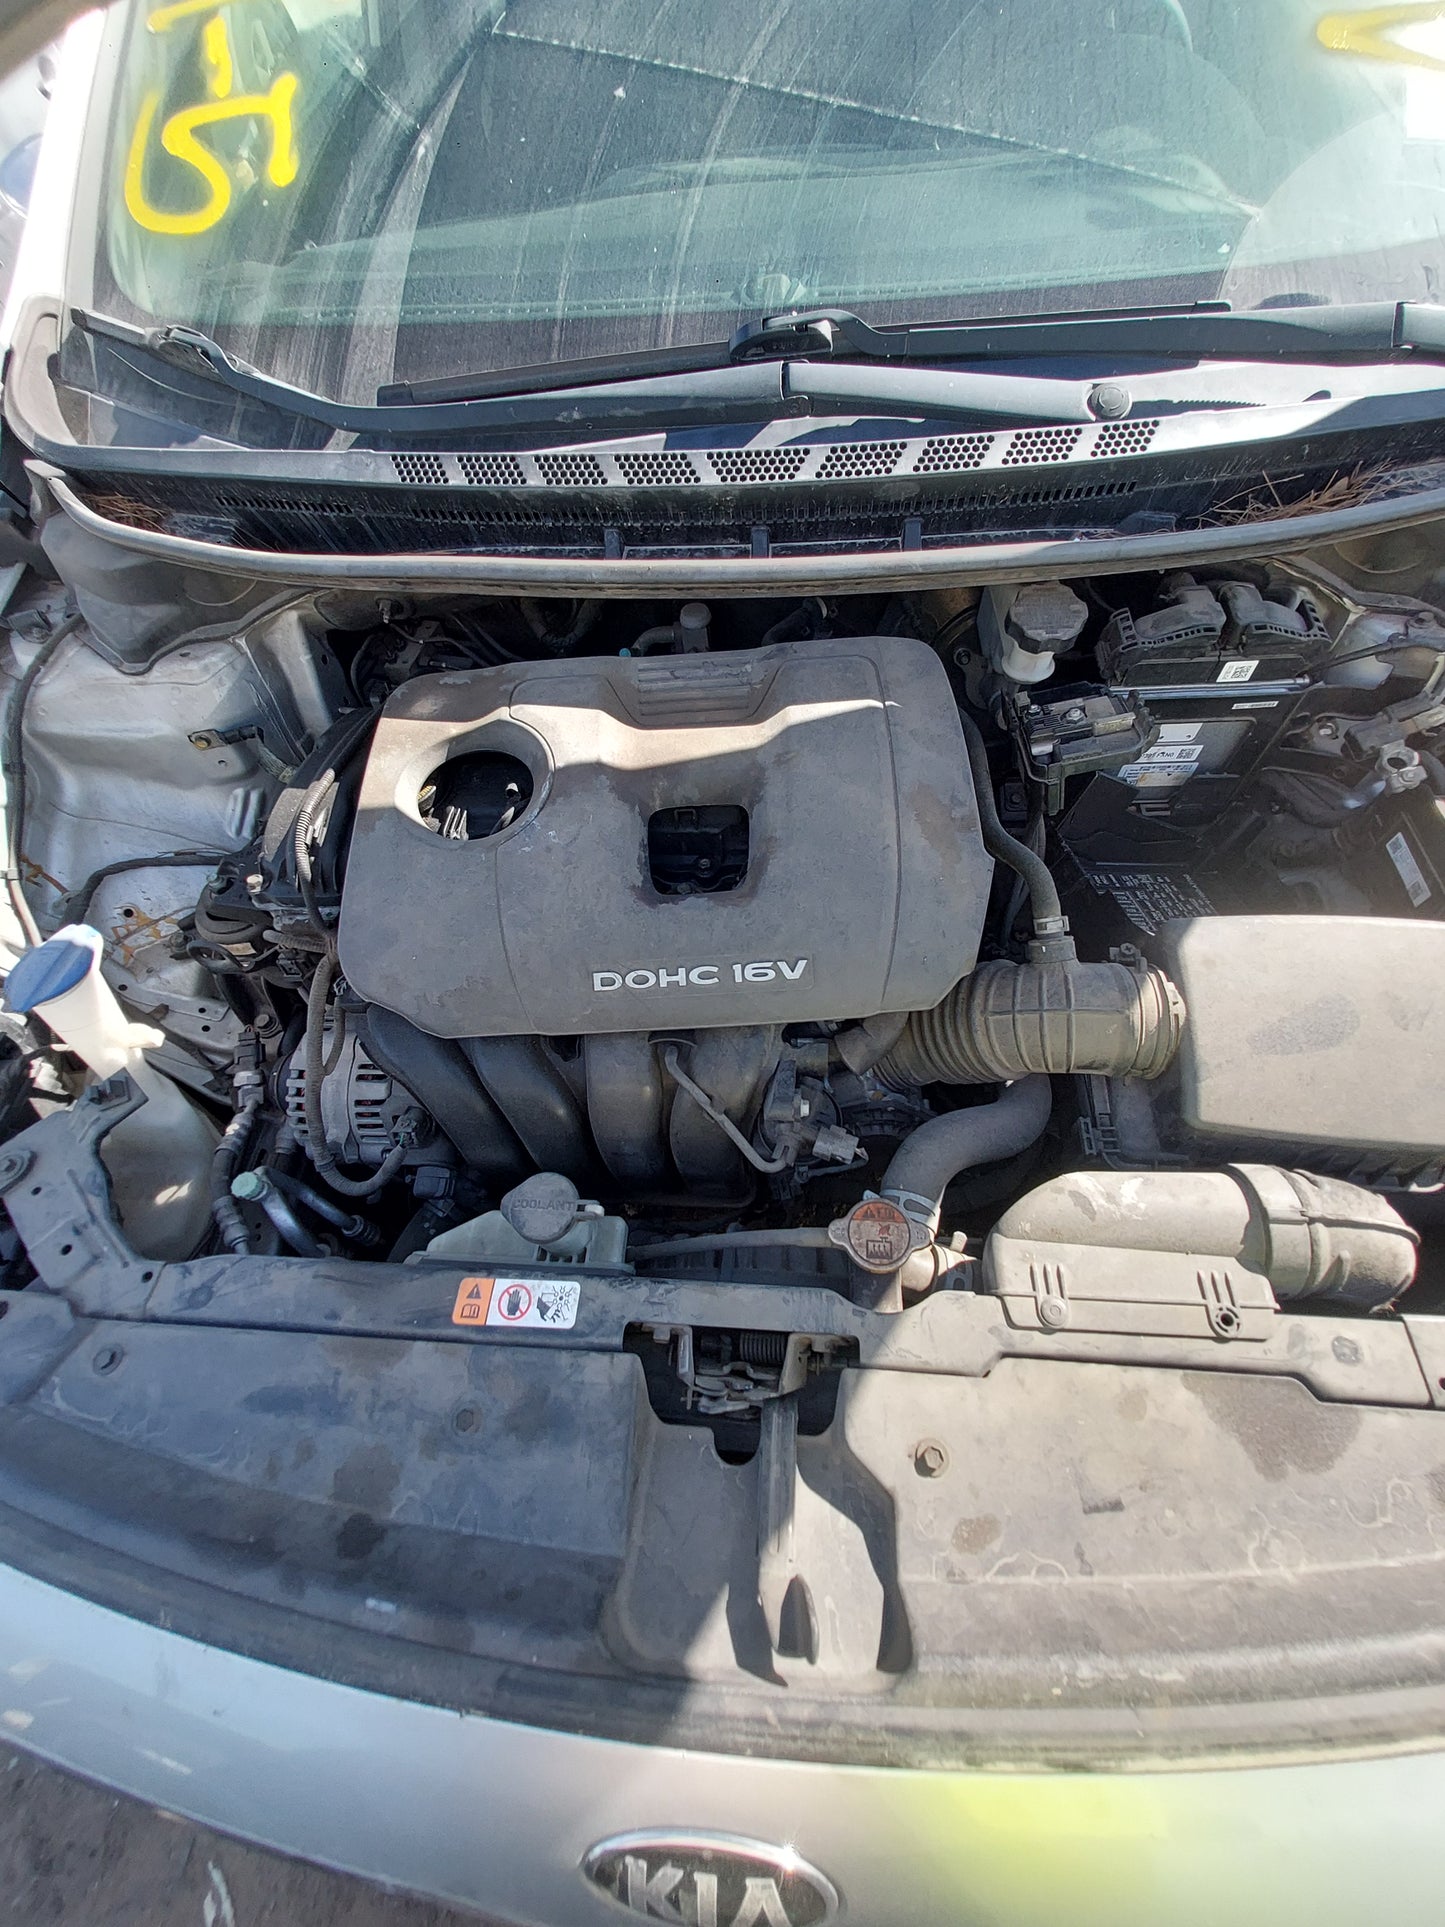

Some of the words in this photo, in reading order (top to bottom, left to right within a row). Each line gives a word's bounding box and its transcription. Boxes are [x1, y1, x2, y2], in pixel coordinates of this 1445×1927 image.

[592, 965, 720, 991] DOHC
[732, 959, 808, 983] 16V
[512, 1199, 575, 1211] COOLANT
[624, 1855, 793, 1927] KIA
